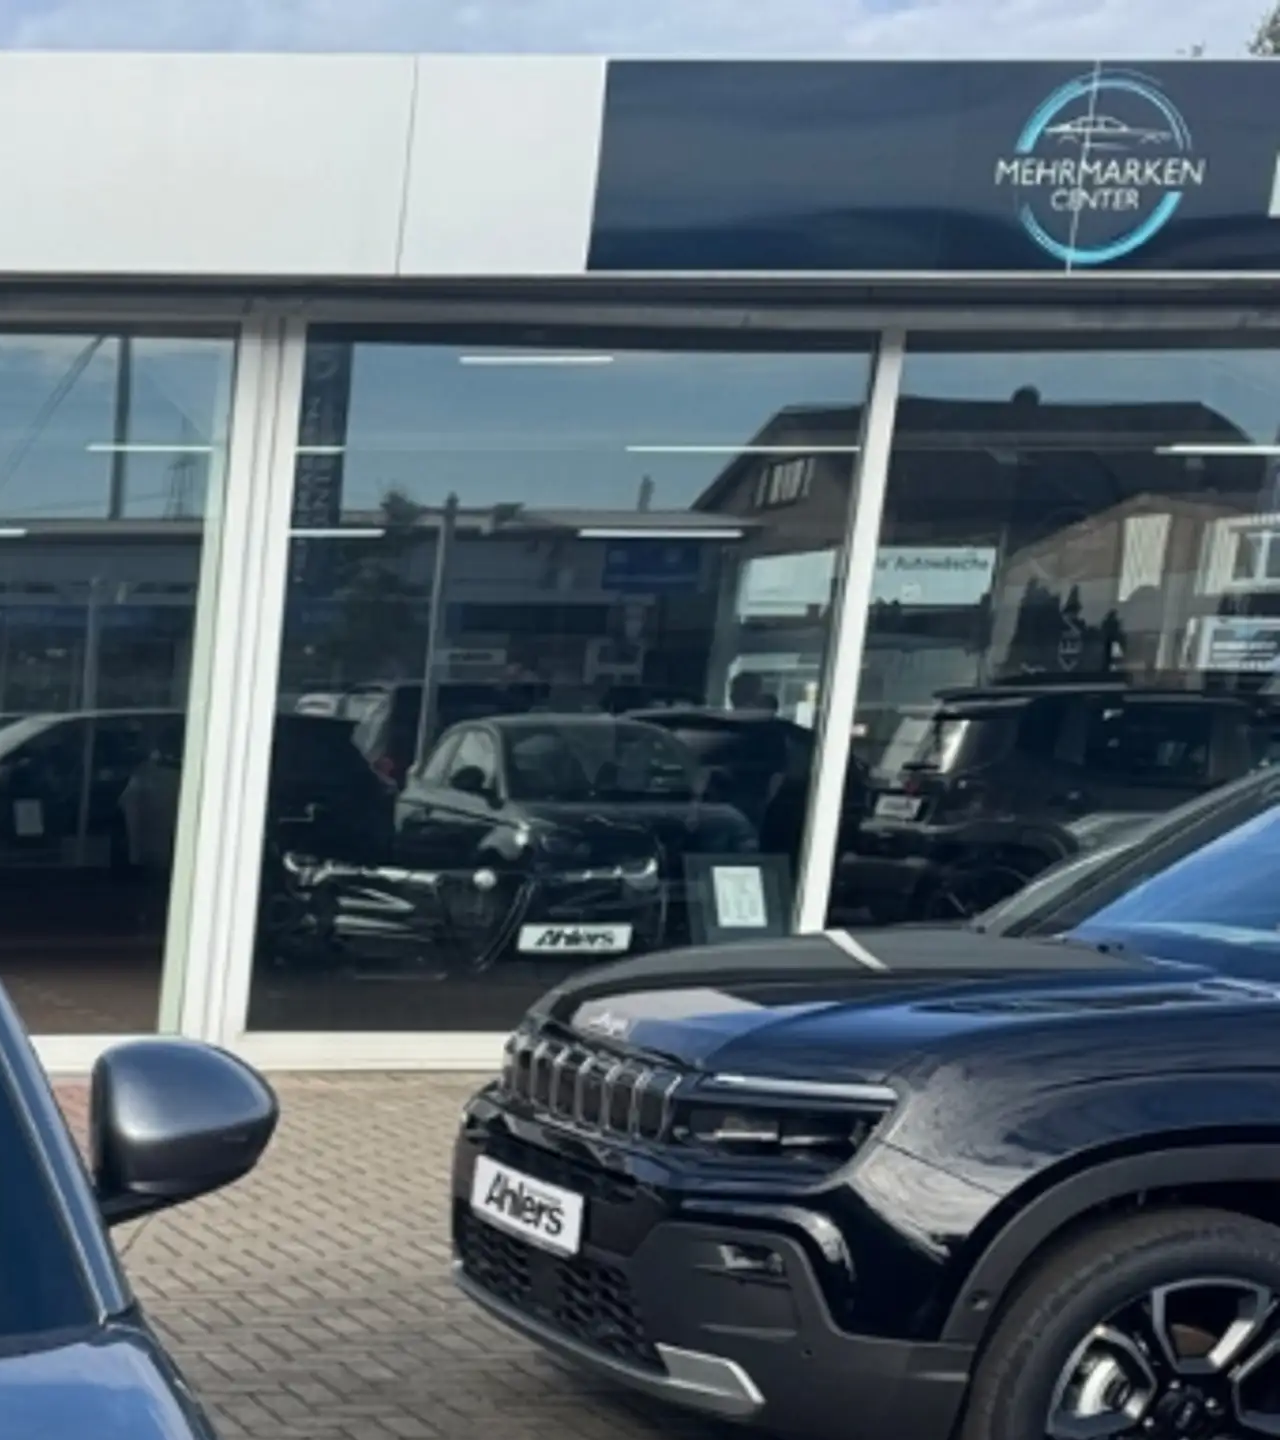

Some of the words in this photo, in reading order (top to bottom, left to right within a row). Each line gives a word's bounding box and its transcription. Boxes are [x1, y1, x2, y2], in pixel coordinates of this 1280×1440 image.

[994, 157, 1206, 186] MEHRMARKEN
[1049, 187, 1140, 212] CENTER
[484, 1169, 566, 1237] Ahlers
